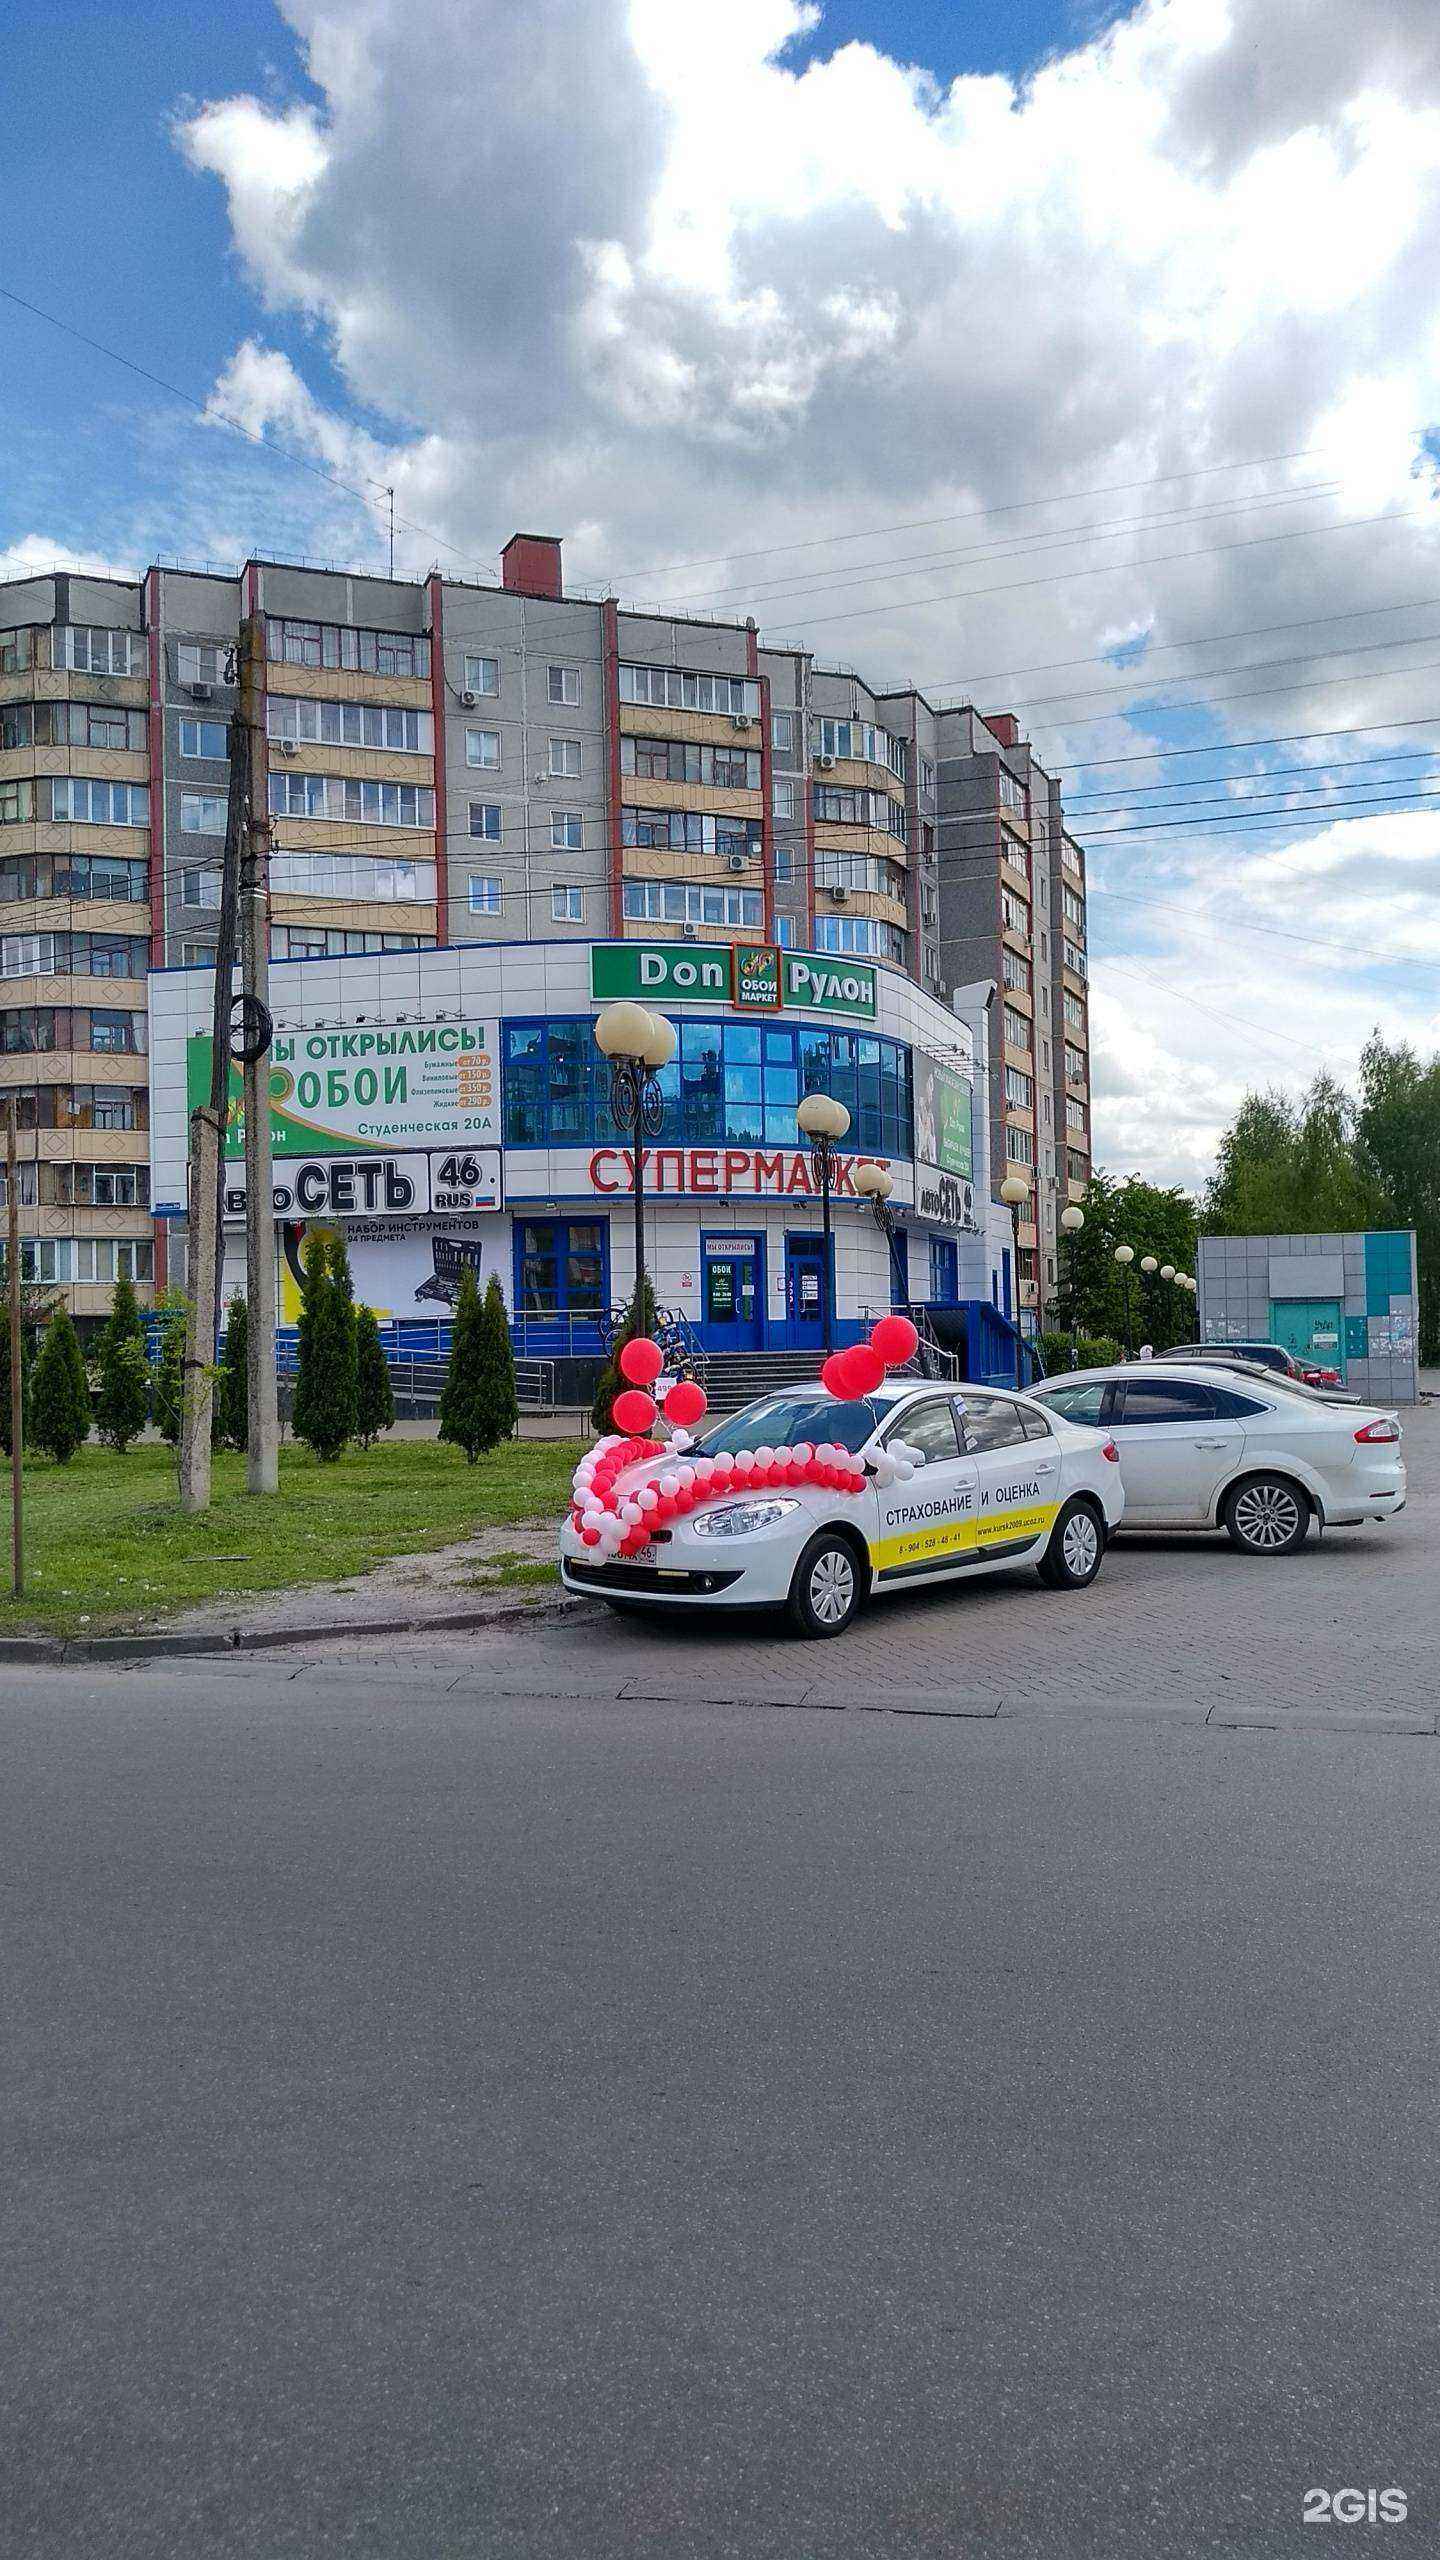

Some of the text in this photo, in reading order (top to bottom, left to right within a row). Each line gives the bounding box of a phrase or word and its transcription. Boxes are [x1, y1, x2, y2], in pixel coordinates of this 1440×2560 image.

[640, 953, 873, 1004] Don Рулон
[742, 979, 777, 991] ОБОИ
[741, 991, 777, 1003] МАРКЕТ
[270, 1026, 485, 1061] Ы ОТКРЫЛИСЬ!
[298, 1066, 408, 1109] ОБОИ
[358, 1117, 491, 1137] Студенческая 20А
[438, 1154, 483, 1188] 46
[435, 1191, 473, 1209] RUS
[347, 1220, 479, 1234] НАБОР ИНСТРУМЕНТОВ
[361, 1233, 406, 1243] ПРЕДМЕТА
[886, 1481, 1040, 1526] СТРАХОВАНИЕ И ОЦЕНКА
